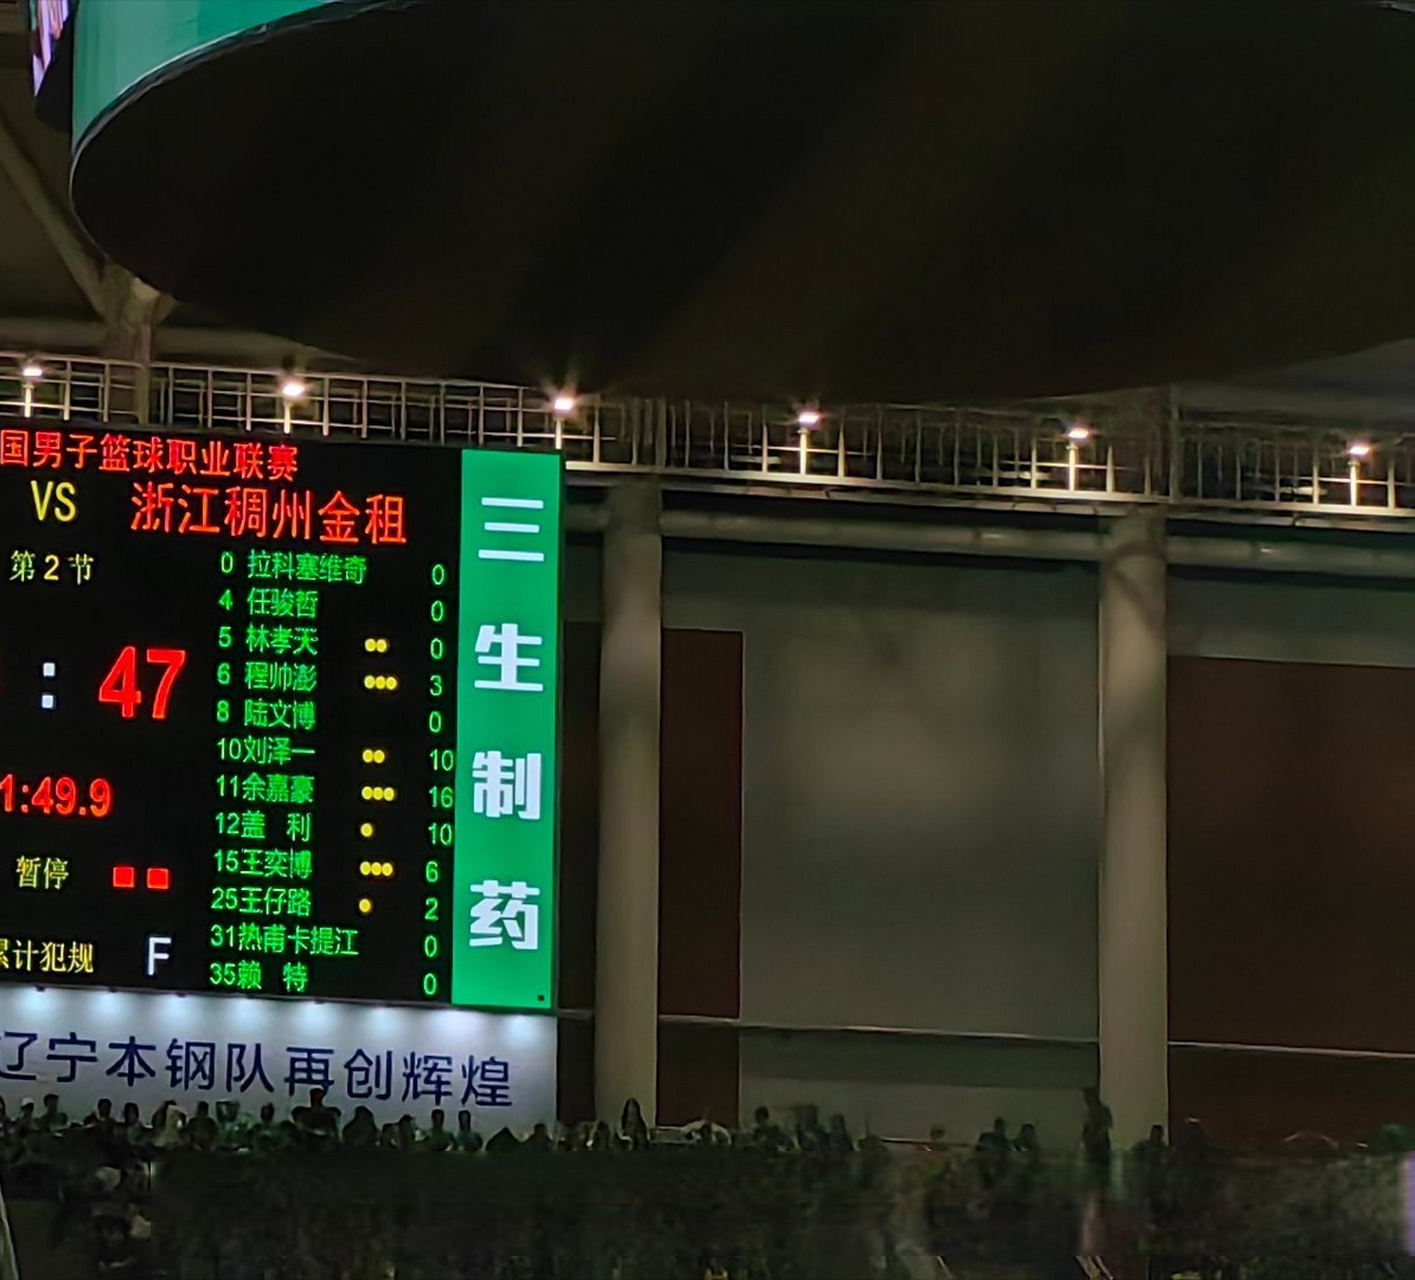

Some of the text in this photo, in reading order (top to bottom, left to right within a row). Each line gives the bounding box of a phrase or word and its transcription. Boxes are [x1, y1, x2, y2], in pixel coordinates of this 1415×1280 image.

[31, 480, 77, 522] VS
[130, 480, 408, 545] 浙江稠州金租
[220, 549, 446, 586] 0 拉科塞维奇 0
[218, 586, 445, 623] 4 任骏哲 0
[218, 622, 444, 661] 5 林孝天 0
[97, 645, 187, 721] 47
[216, 661, 443, 697] 6 程帅澎 3
[216, 698, 443, 734] 8 陆文博 0
[469, 497, 545, 950] 三生制药
[429, 748, 455, 772] 10
[428, 785, 454, 809] 16
[427, 822, 454, 847] 10
[17, 855, 69, 889] 暂停
[425, 860, 440, 884] 6
[424, 896, 440, 922] 2
[147, 936, 172, 976] F
[423, 934, 439, 958] 0
[422, 972, 438, 996] 0
